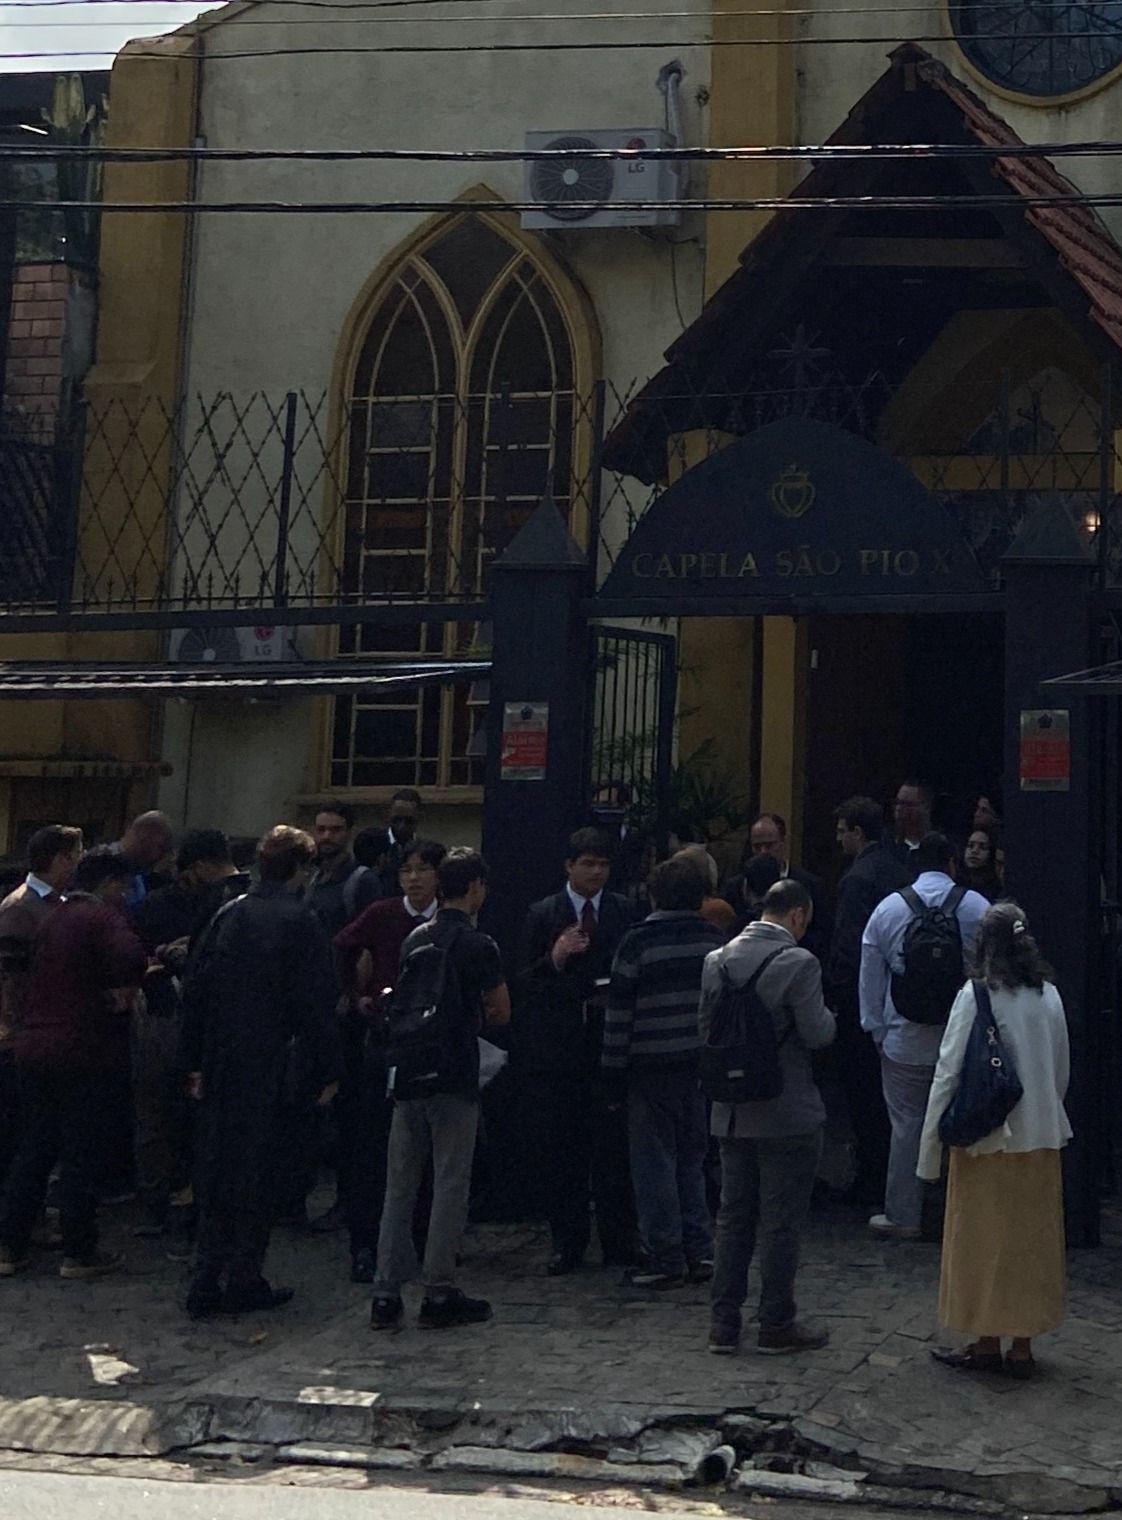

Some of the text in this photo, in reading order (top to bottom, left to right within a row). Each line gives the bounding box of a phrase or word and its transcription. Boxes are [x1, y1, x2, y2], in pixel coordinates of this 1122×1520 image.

[628, 163, 645, 173] LG
[631, 546, 953, 578] CAPELA SÃO PIO X
[256, 645, 271, 655] LG
